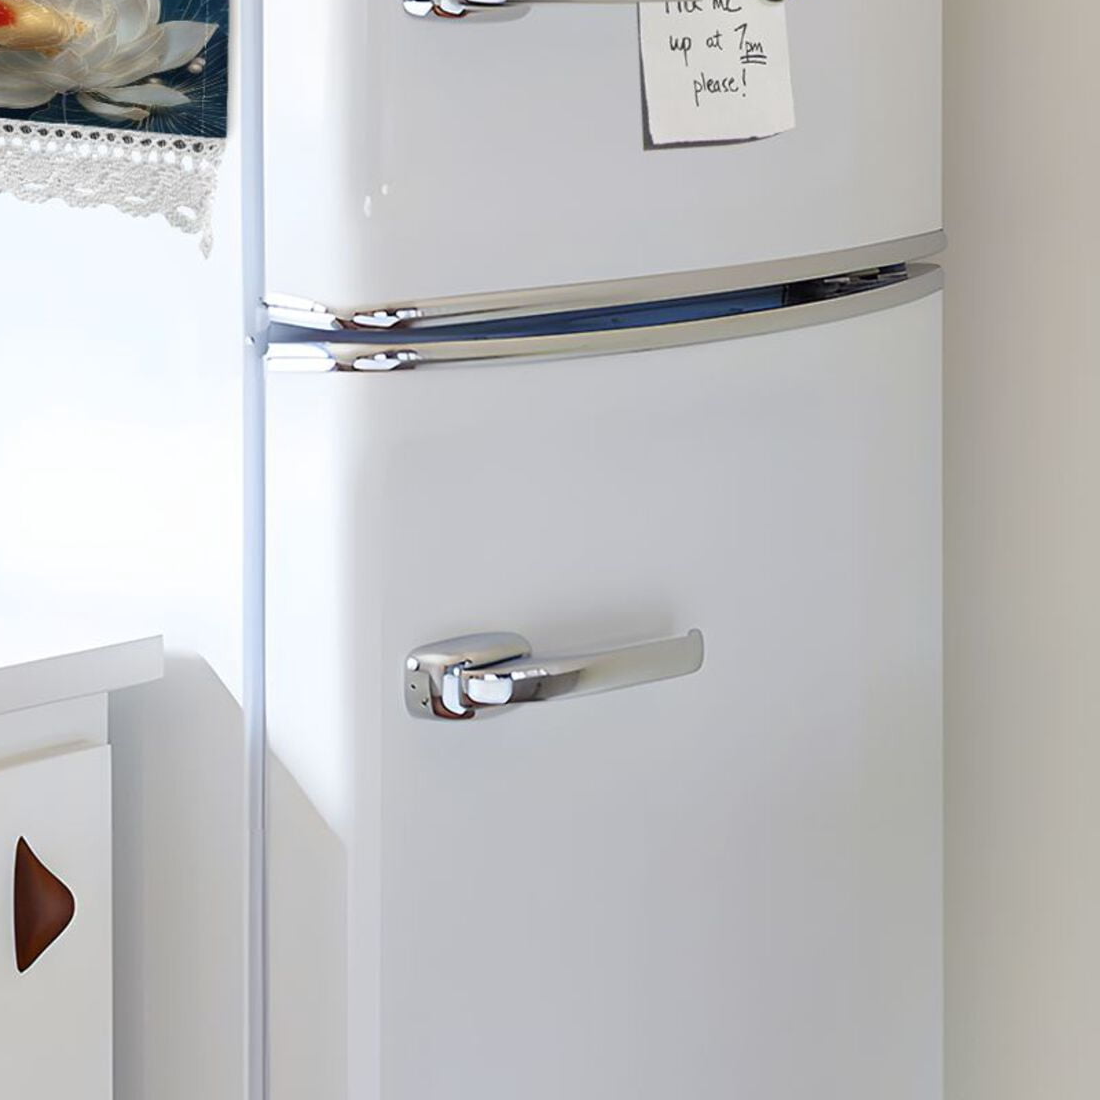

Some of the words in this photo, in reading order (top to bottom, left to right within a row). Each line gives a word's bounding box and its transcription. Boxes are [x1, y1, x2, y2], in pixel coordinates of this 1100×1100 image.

[669, 35, 692, 66] up
[706, 30, 723, 51] at
[693, 68, 747, 107] please!
